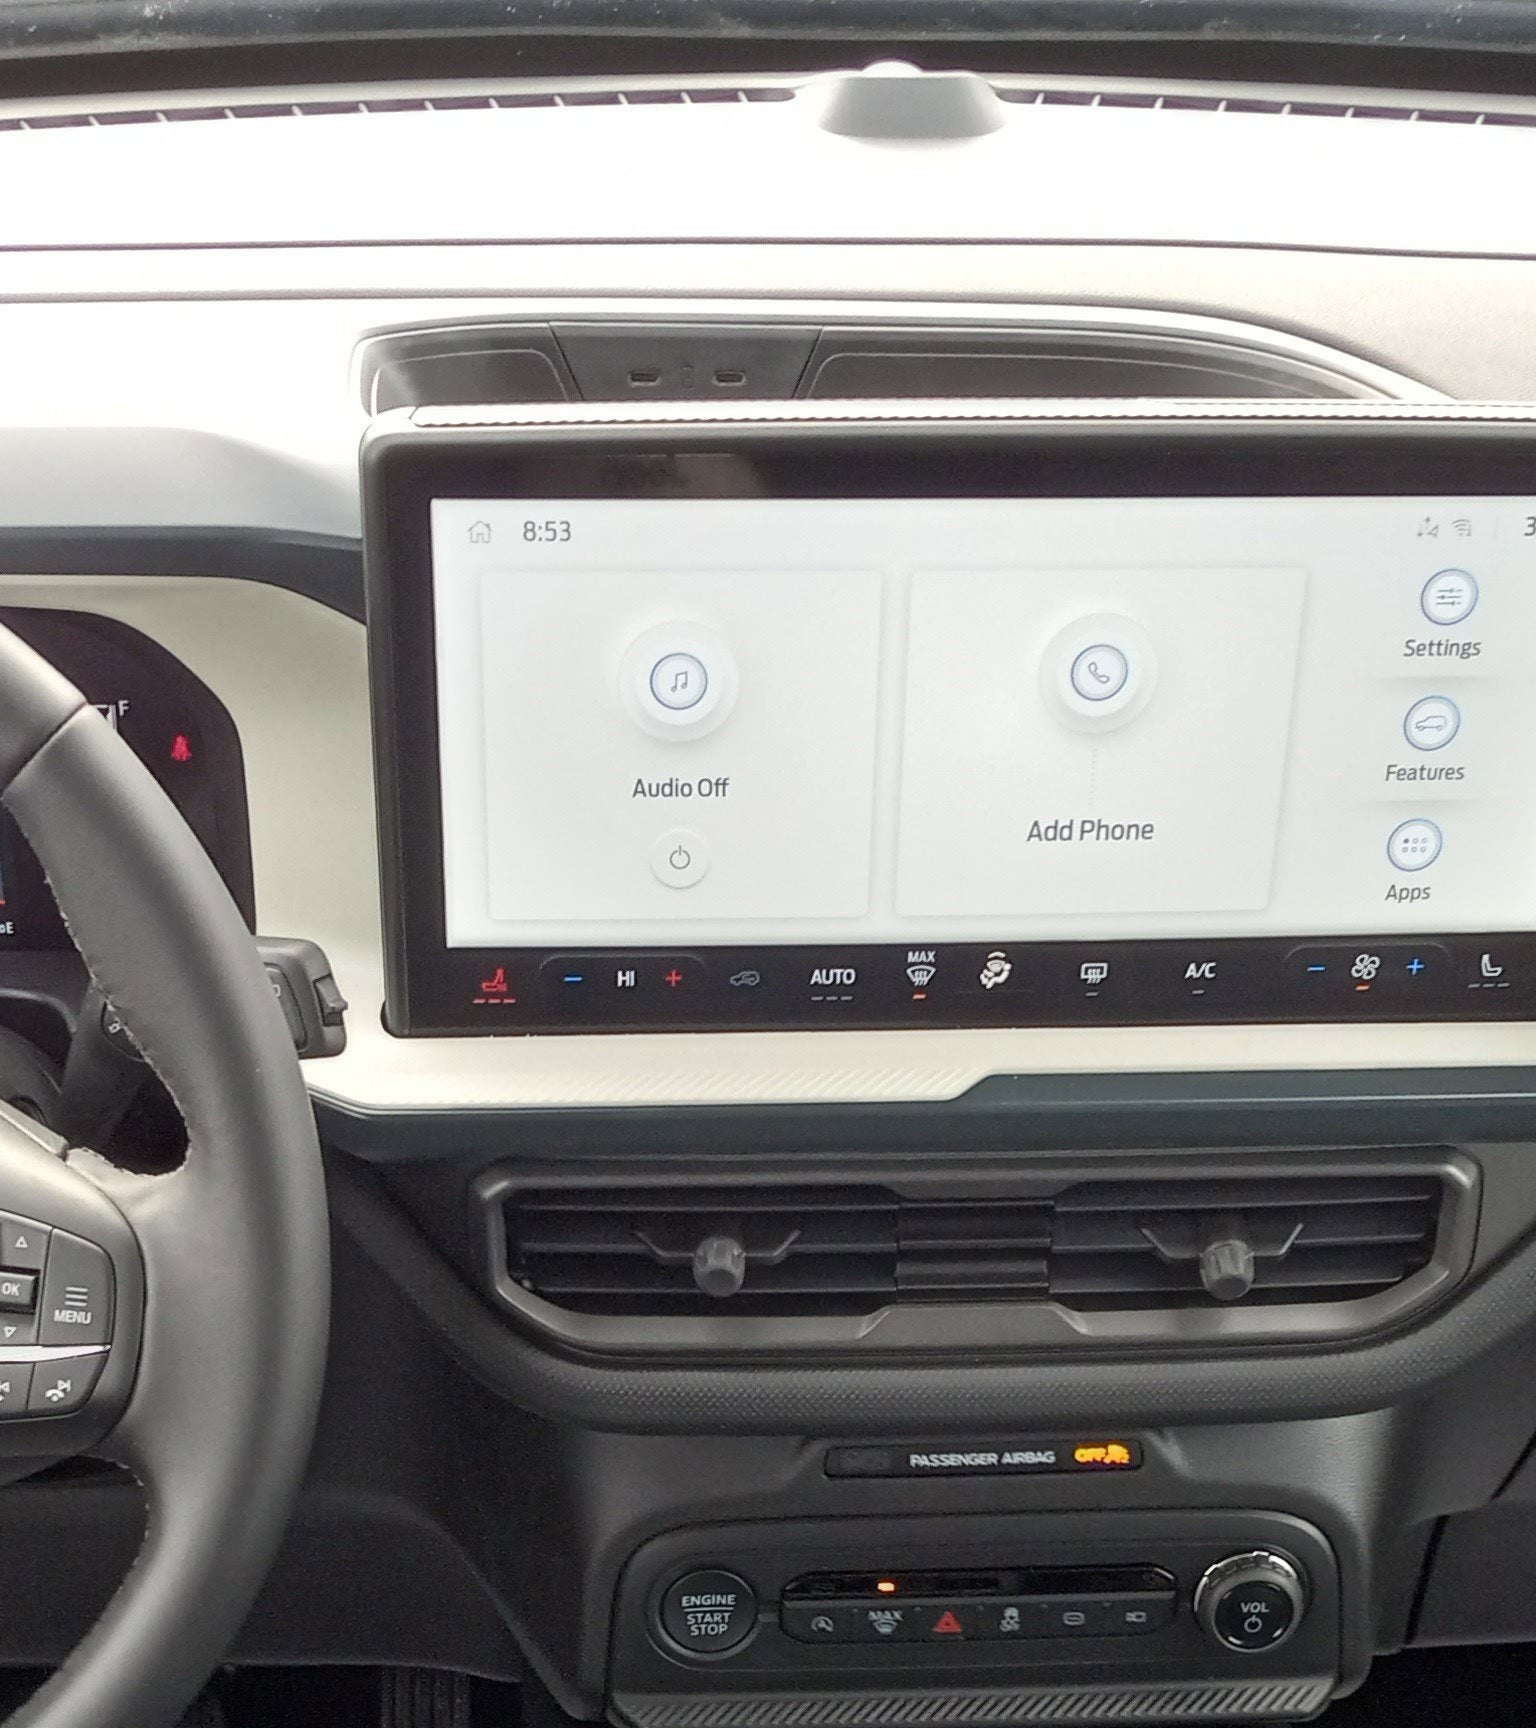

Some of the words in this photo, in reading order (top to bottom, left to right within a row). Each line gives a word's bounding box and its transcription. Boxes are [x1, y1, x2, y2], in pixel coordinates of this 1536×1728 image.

[521, 520, 573, 544] 8:53
[1403, 637, 1482, 660] Settings
[118, 699, 130, 717] F
[1385, 762, 1465, 784] Features
[632, 777, 693, 799] Audio
[697, 777, 730, 799] Off
[1026, 818, 1075, 843] Add
[1080, 817, 1154, 843] Phone
[1384, 882, 1431, 905] Apps
[907, 950, 937, 964] MAX
[616, 969, 636, 988] HI
[810, 967, 857, 987] AUTO
[1184, 960, 1217, 981] A/C
[1, 1282, 21, 1297] OK
[53, 1309, 93, 1326] MENU
[909, 1452, 998, 1468] PASSENGER
[1001, 1451, 1056, 1466] AIRBAG
[681, 1593, 737, 1608] ENGINE
[1240, 1602, 1270, 1614] VOL
[686, 1612, 732, 1626] START
[866, 1609, 905, 1623] MAX
[690, 1624, 729, 1637] STOP
